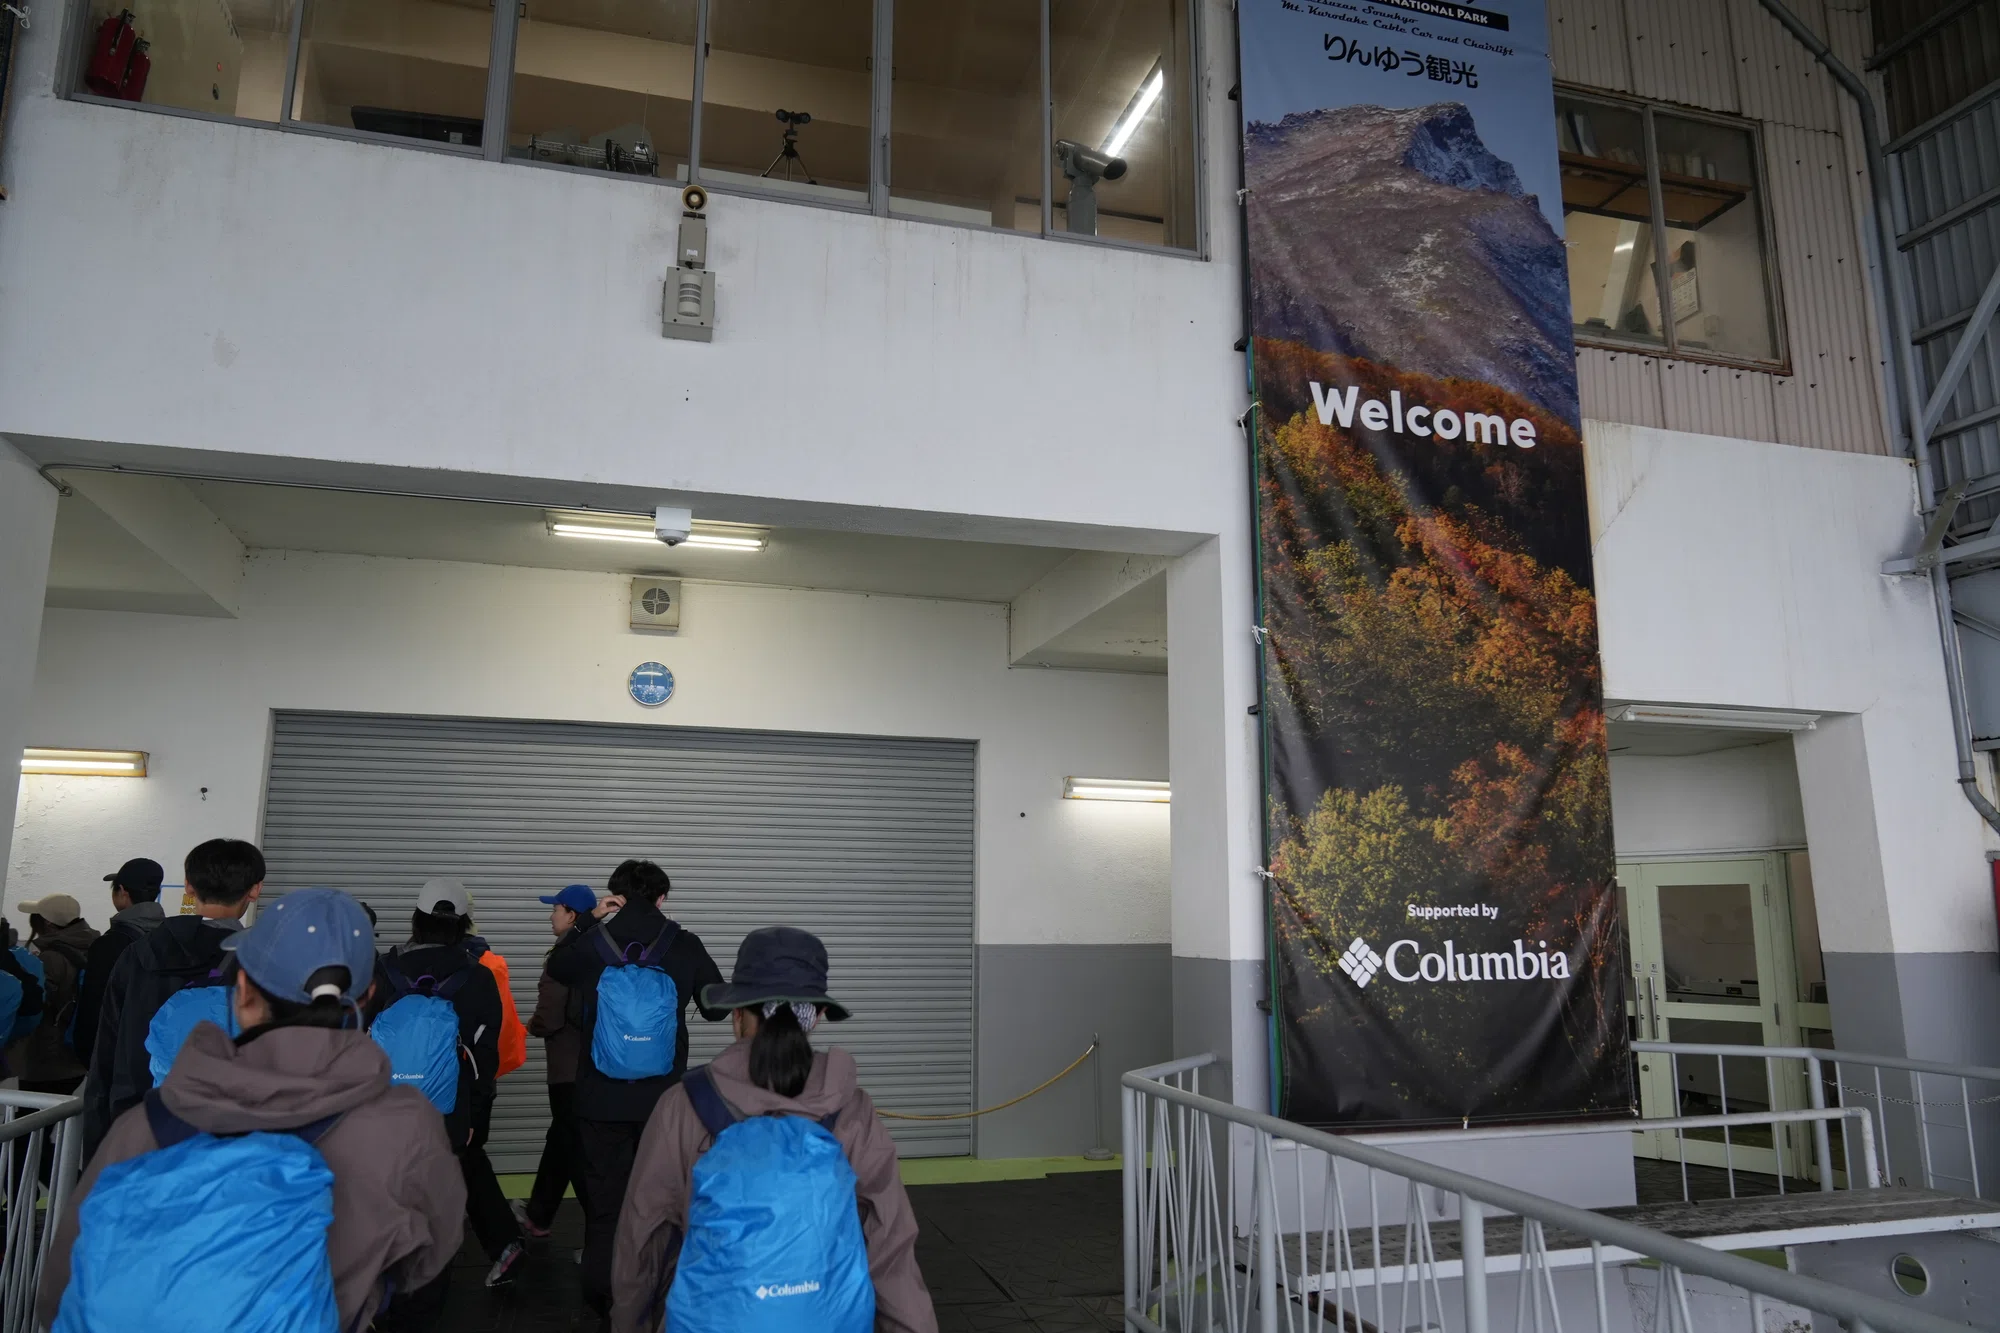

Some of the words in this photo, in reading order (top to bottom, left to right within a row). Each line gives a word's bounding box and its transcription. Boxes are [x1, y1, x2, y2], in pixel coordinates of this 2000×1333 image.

[1281, 0, 1304, 13] Mt.
[1307, 5, 1368, 26] Kurodake
[1373, 19, 1407, 33] Cable
[1411, 27, 1433, 39] Car
[1437, 35, 1459, 45] and
[1463, 38, 1514, 56] Chairlift
[1361, 5, 1419, 24] Sounkyo
[1391, 0, 1455, 17] NATIONAL
[1457, 8, 1488, 24] PARK
[1324, 33, 1478, 89] りんゆう観光
[1309, 381, 1536, 449] Welcome
[1407, 903, 1479, 920] Supported
[1482, 903, 1498, 920] by
[1385, 939, 1570, 982] Columbia
[768, 1280, 820, 1298] Columbia
